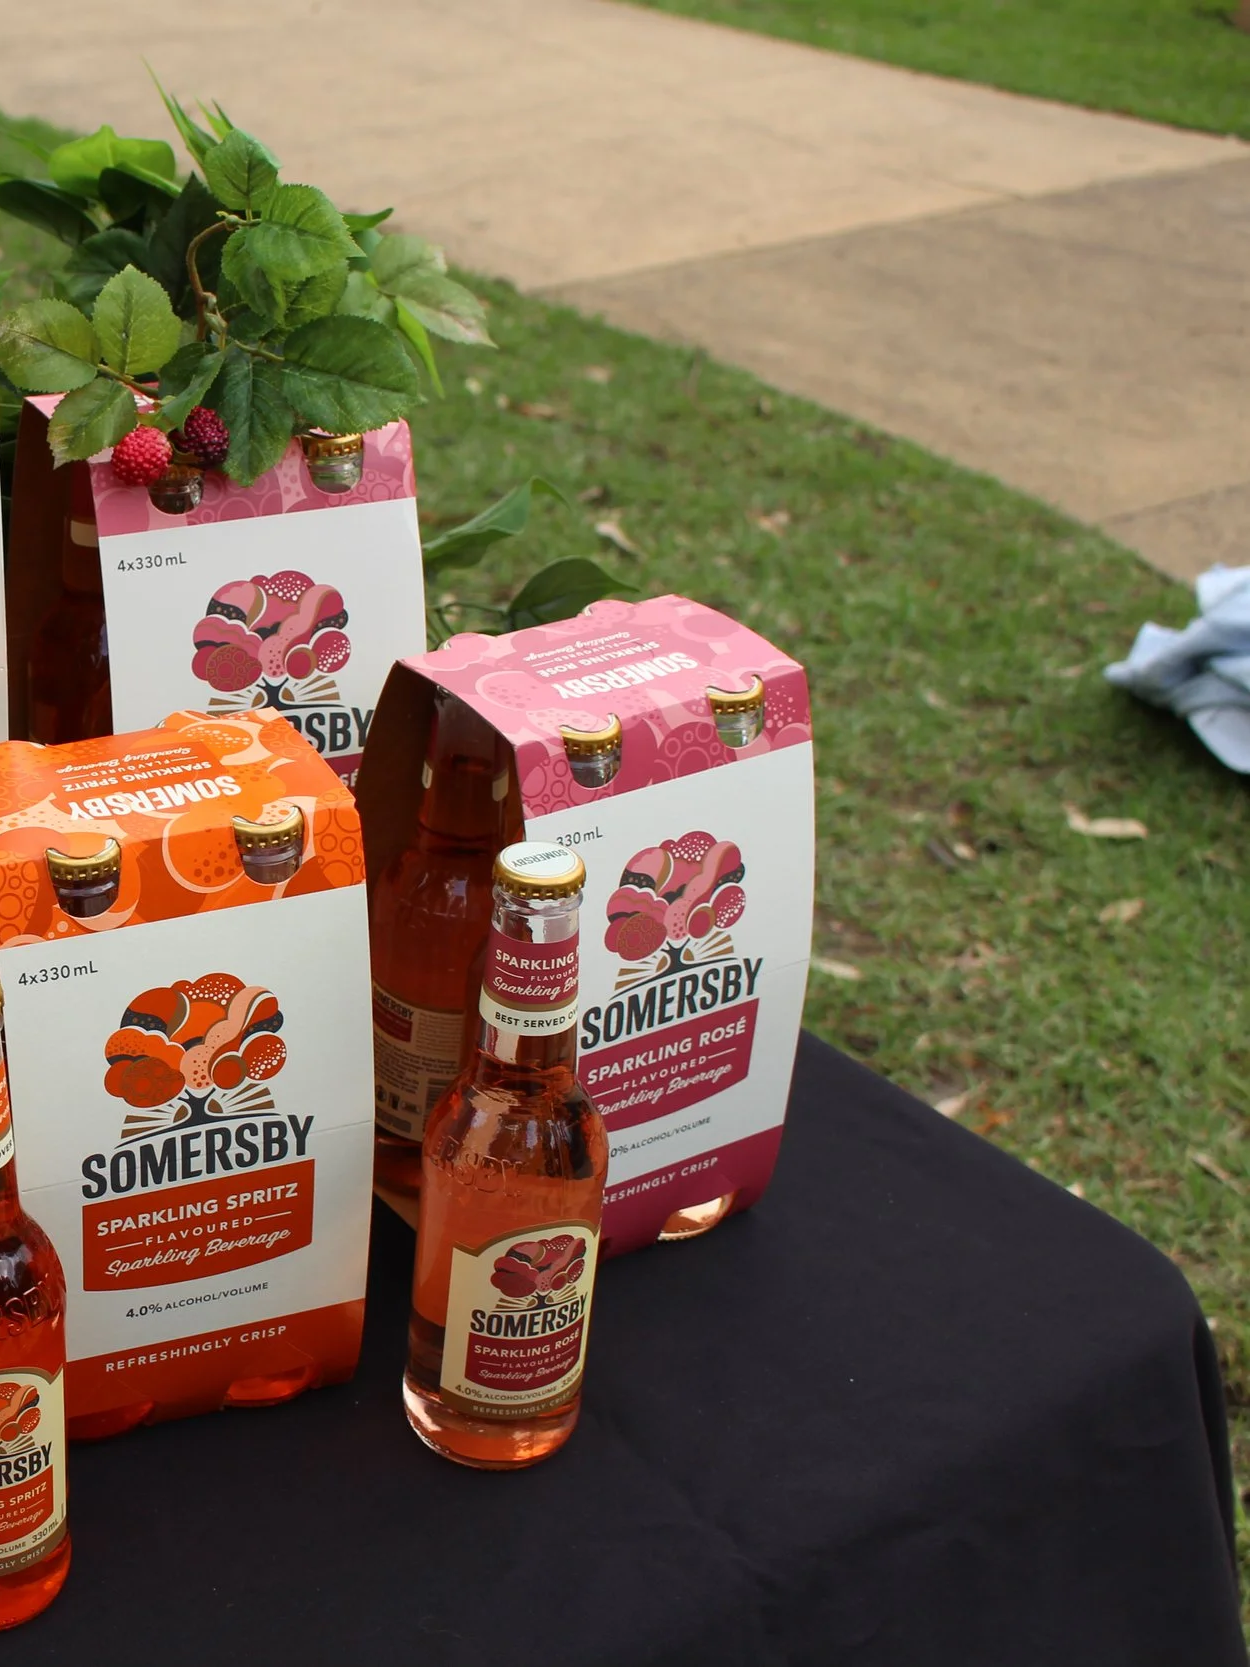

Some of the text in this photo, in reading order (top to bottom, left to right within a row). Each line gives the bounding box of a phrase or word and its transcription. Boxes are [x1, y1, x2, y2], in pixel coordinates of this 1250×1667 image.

[117, 552, 187, 573] 4x330 mL
[578, 641, 660, 666] SPARKLING
[551, 652, 698, 699] SOMERSBY
[91, 759, 170, 777] FLAVOURED
[122, 746, 192, 763] Sparkling
[62, 761, 212, 792] SPARKLING SPRITZ
[68, 775, 242, 820] SOMERSBY
[583, 826, 603, 842] mL
[511, 849, 569, 868] SOMERSBY
[18, 959, 98, 987] 4x330 mL
[495, 949, 574, 970] SPARKLING
[493, 976, 561, 1000] Sparkling
[580, 957, 762, 1050] SOMERSBY
[495, 1011, 520, 1026] BEST
[523, 1016, 566, 1028] SERVED
[587, 1016, 747, 1085] SPARKLING ROSÉ
[623, 1056, 707, 1091] FLAVOURED
[666, 1064, 732, 1096] Beverage
[629, 1116, 711, 1151] ALCOHOL/VOLUME
[81, 1114, 315, 1199] SOMERSBY
[681, 1156, 718, 1177] CRISP
[96, 1182, 298, 1238] SPARKLING SPRITZ
[145, 1216, 253, 1246] FLAVOURED
[105, 1227, 291, 1277] Sparkling Beverage
[126, 1282, 268, 1319] 4.0% ALCOHOL/VOLUME
[470, 1291, 588, 1337] SOMERSBY
[105, 1324, 287, 1373] REFRESHINGLY CRISP
[474, 1328, 580, 1358] SPARKLING ROSÉ
[479, 1369, 533, 1381] Sparkling
[502, 1354, 561, 1368] FLAVOURED
[455, 1385, 483, 1399] 4.0%
[9, 1481, 47, 1507] SPRITZ
[31, 1527, 48, 1543] 330
[20, 1546, 46, 1563] CRISP
